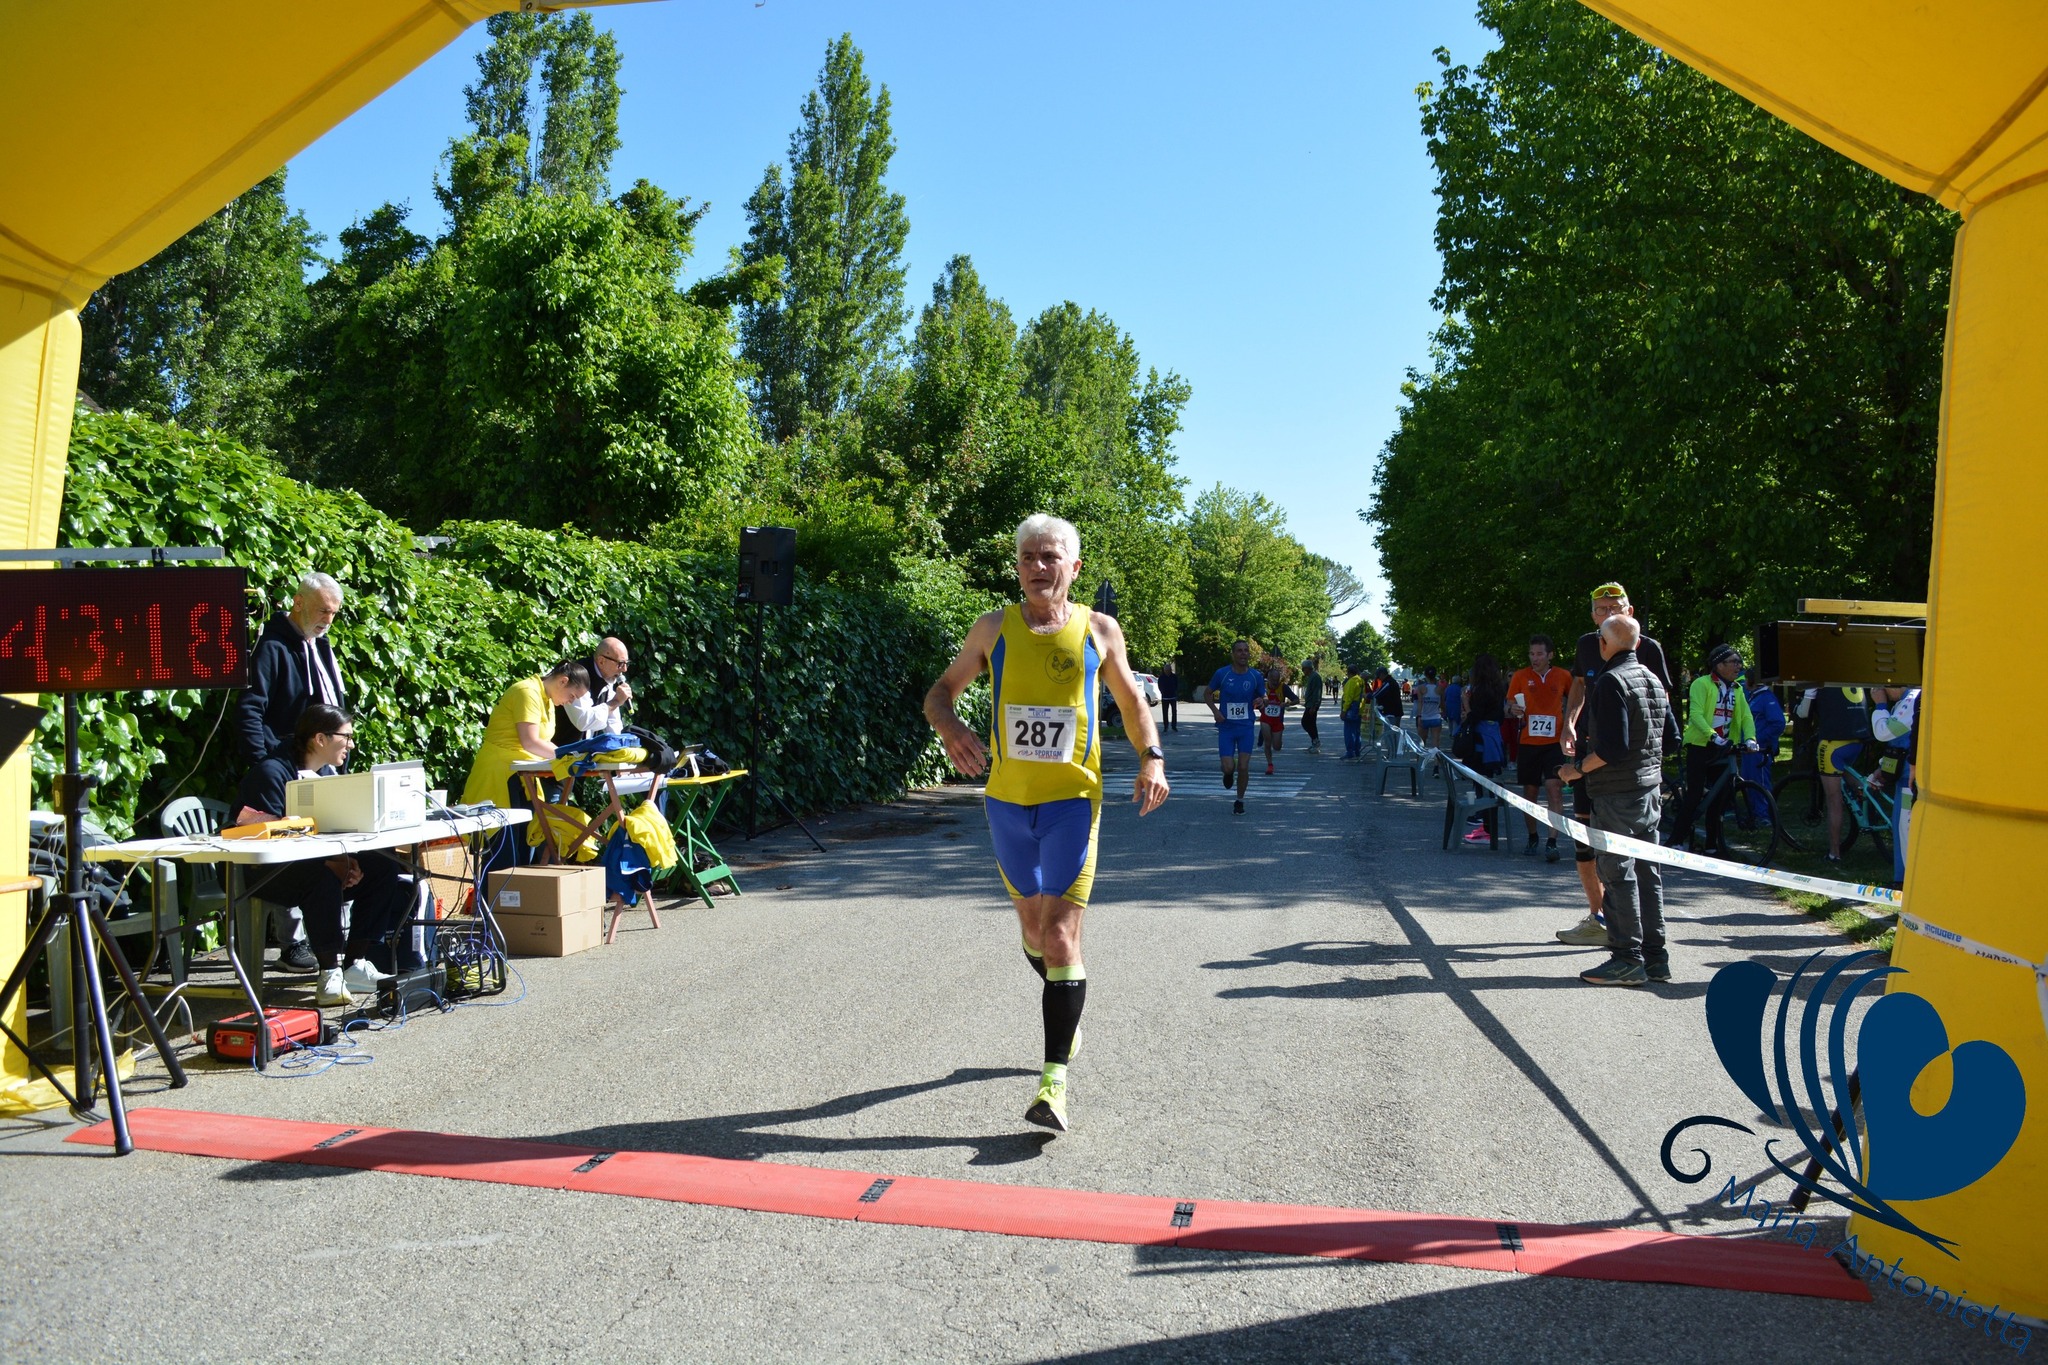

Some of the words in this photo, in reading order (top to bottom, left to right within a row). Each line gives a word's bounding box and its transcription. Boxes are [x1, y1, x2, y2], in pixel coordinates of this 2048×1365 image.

[1230, 707, 1246, 716] 184
[1266, 707, 1279, 715] 275
[1532, 720, 1552, 731] 274
[1015, 720, 1065, 748] 287
